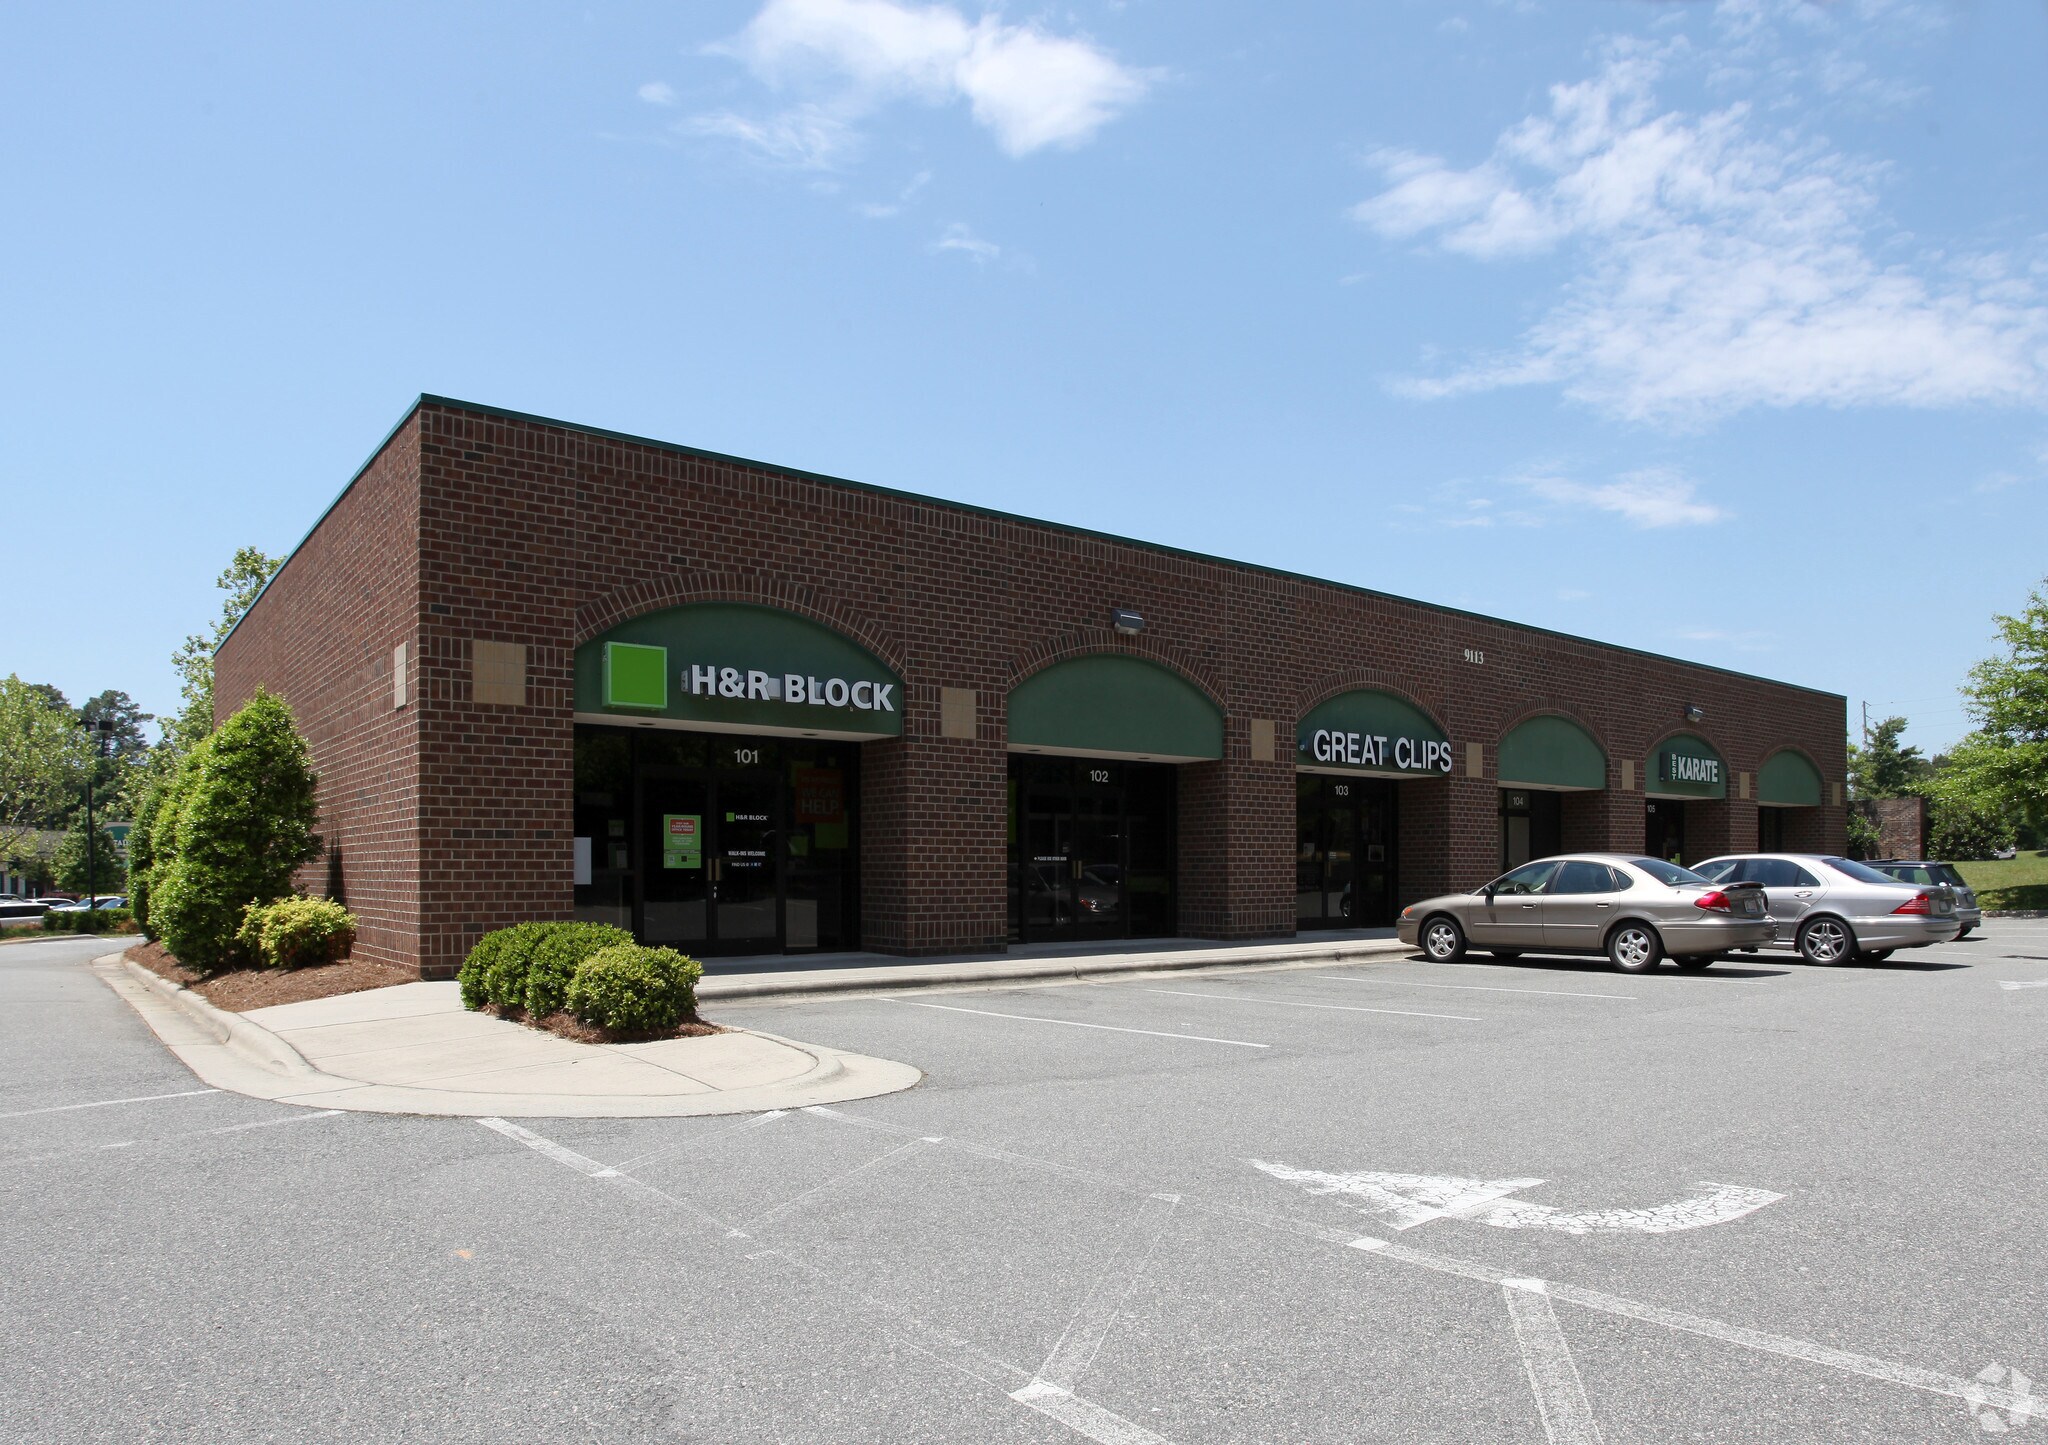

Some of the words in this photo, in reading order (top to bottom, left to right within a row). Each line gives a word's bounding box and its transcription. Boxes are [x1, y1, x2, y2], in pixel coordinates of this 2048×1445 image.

[1464, 648, 1484, 665] 9113
[691, 664, 771, 701] H&R
[785, 674, 895, 712] BLOCK
[733, 748, 760, 764] 101
[1313, 729, 1387, 766] GREAT
[1394, 736, 1453, 773] CLIPS
[1089, 769, 1109, 783] 102
[1678, 756, 1718, 783] KARATE
[1334, 785, 1349, 796] 103
[1512, 796, 1524, 806] 104
